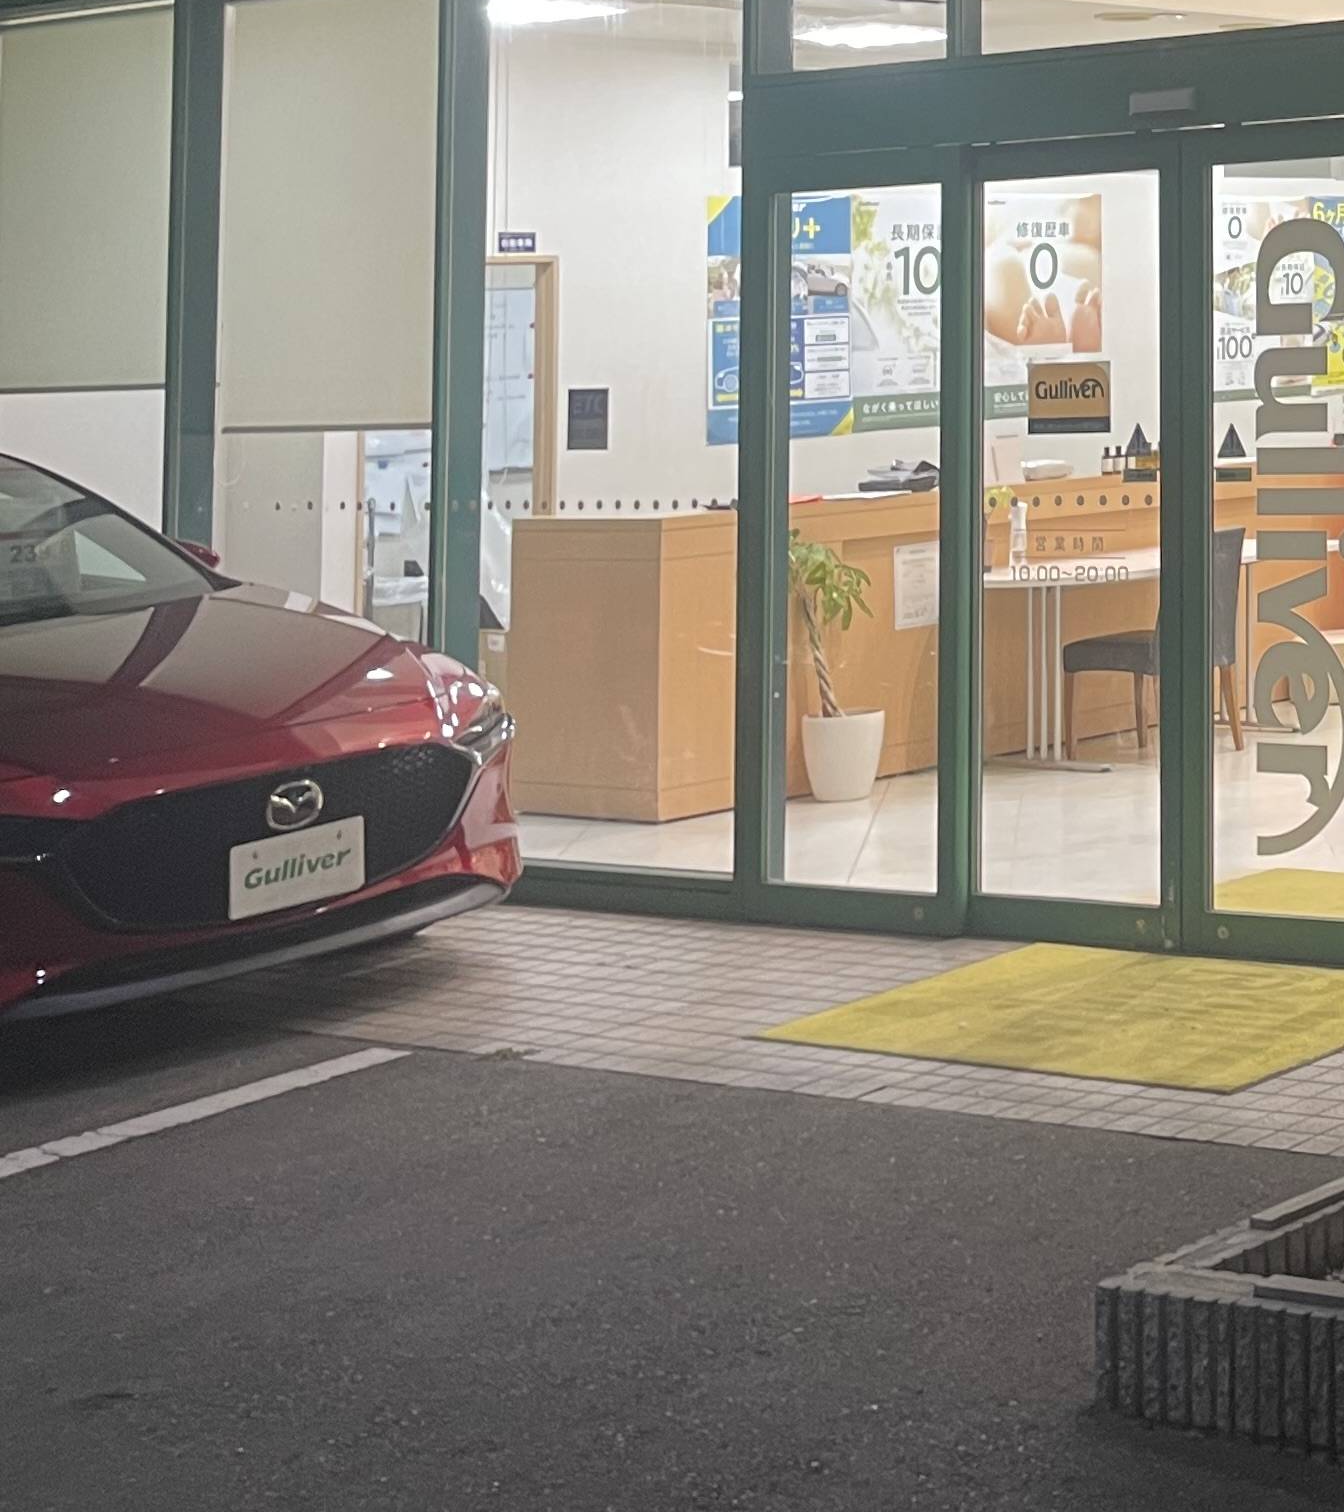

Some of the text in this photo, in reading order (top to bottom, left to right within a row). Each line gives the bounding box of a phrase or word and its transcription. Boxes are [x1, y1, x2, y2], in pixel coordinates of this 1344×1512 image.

[891, 224, 941, 241] 長期保
[1016, 222, 1070, 238] 修復歴車
[1030, 242, 1058, 289] 0
[1035, 378, 1104, 400] Gulliver
[244, 844, 351, 890] Gulliver
